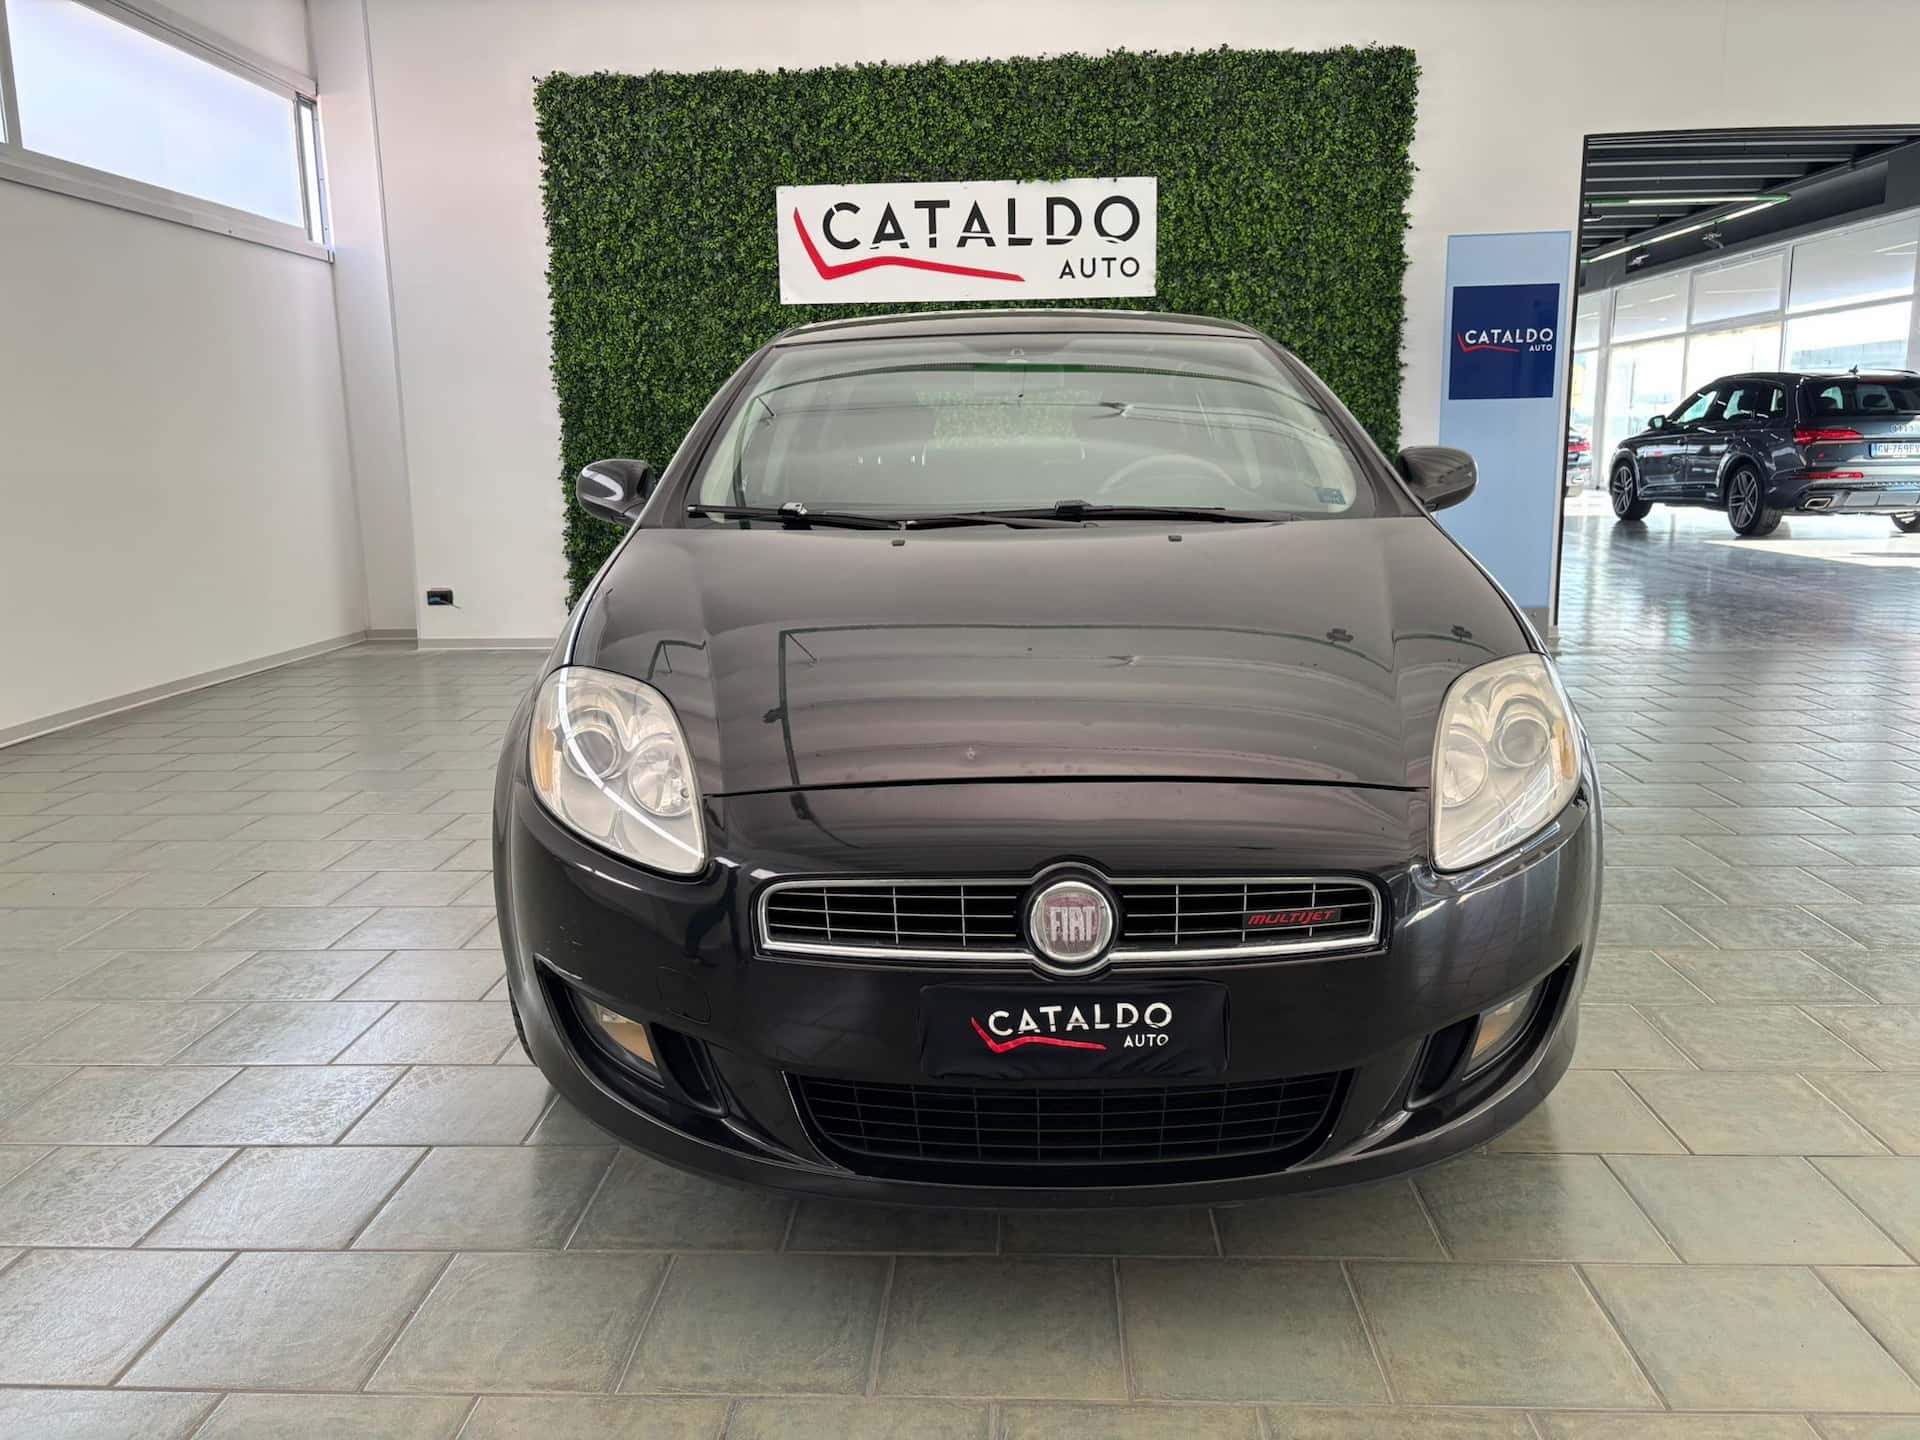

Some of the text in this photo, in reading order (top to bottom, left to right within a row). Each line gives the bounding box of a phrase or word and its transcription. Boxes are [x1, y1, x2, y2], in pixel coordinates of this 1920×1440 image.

[822, 195, 1140, 250] CATALDO
[1059, 257, 1140, 279] AUTO
[1465, 328, 1553, 344] CATALDO
[1529, 344, 1553, 352] AUTO
[1050, 906, 1096, 942] FIAT
[1247, 909, 1335, 926] MULTIJET
[988, 1002, 1172, 1036] CATALDO
[1123, 1034, 1169, 1048] AUTO
